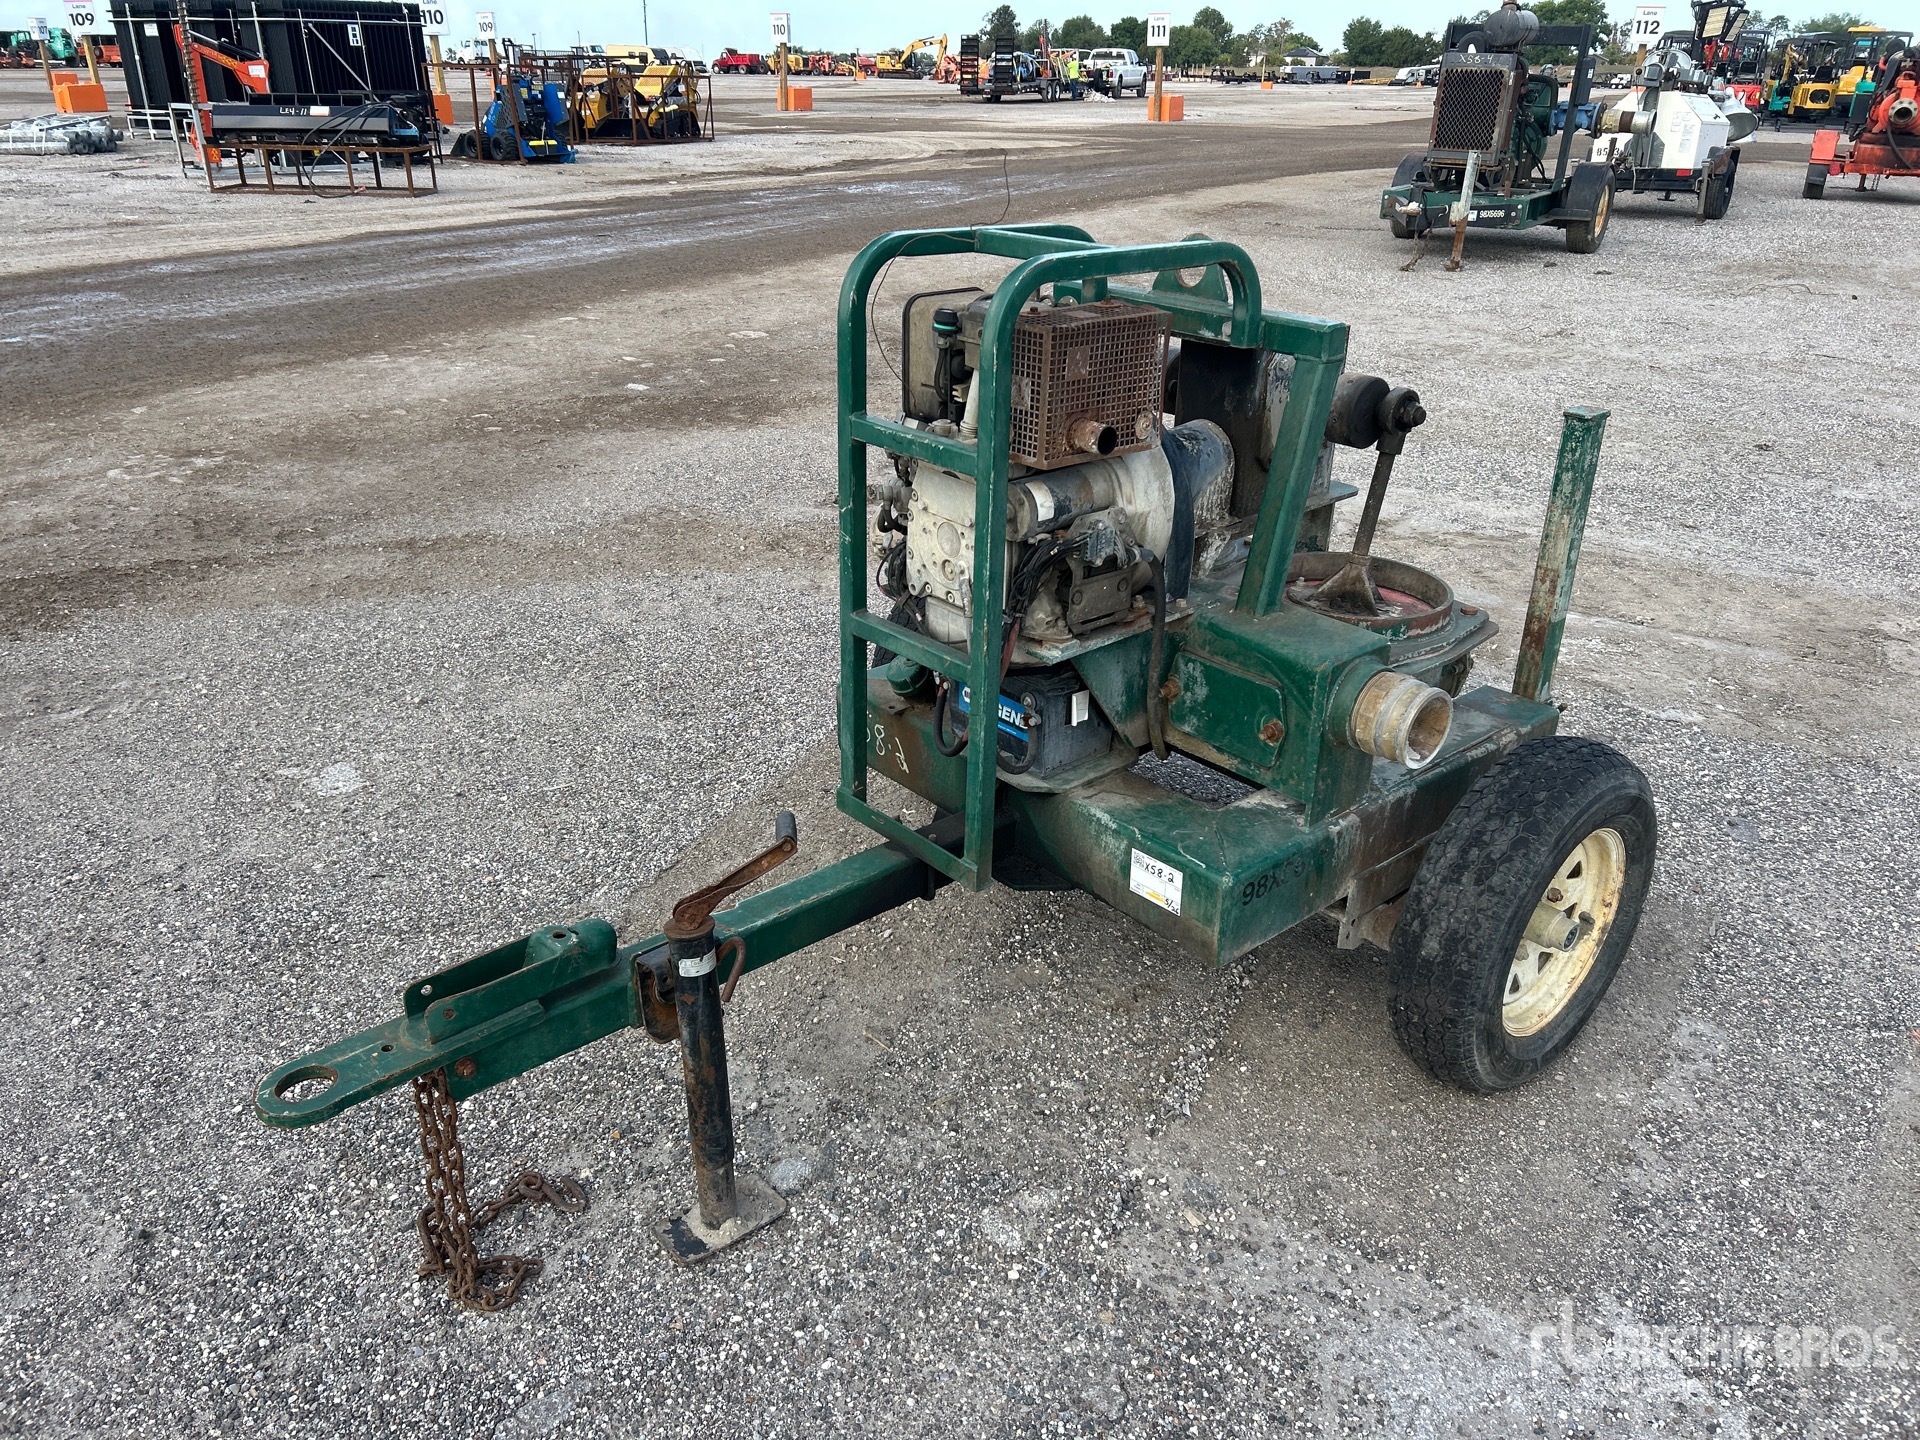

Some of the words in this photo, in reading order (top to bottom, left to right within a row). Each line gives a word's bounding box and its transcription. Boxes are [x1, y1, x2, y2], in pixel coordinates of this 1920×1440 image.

[69, 12, 95, 26] 109
[420, 9, 444, 25] 110
[478, 21, 493, 32] 109
[772, 24, 786, 36] 110
[1150, 24, 1166, 38] 111
[1635, 20, 1661, 35] 112
[1596, 147, 1620, 157] 853
